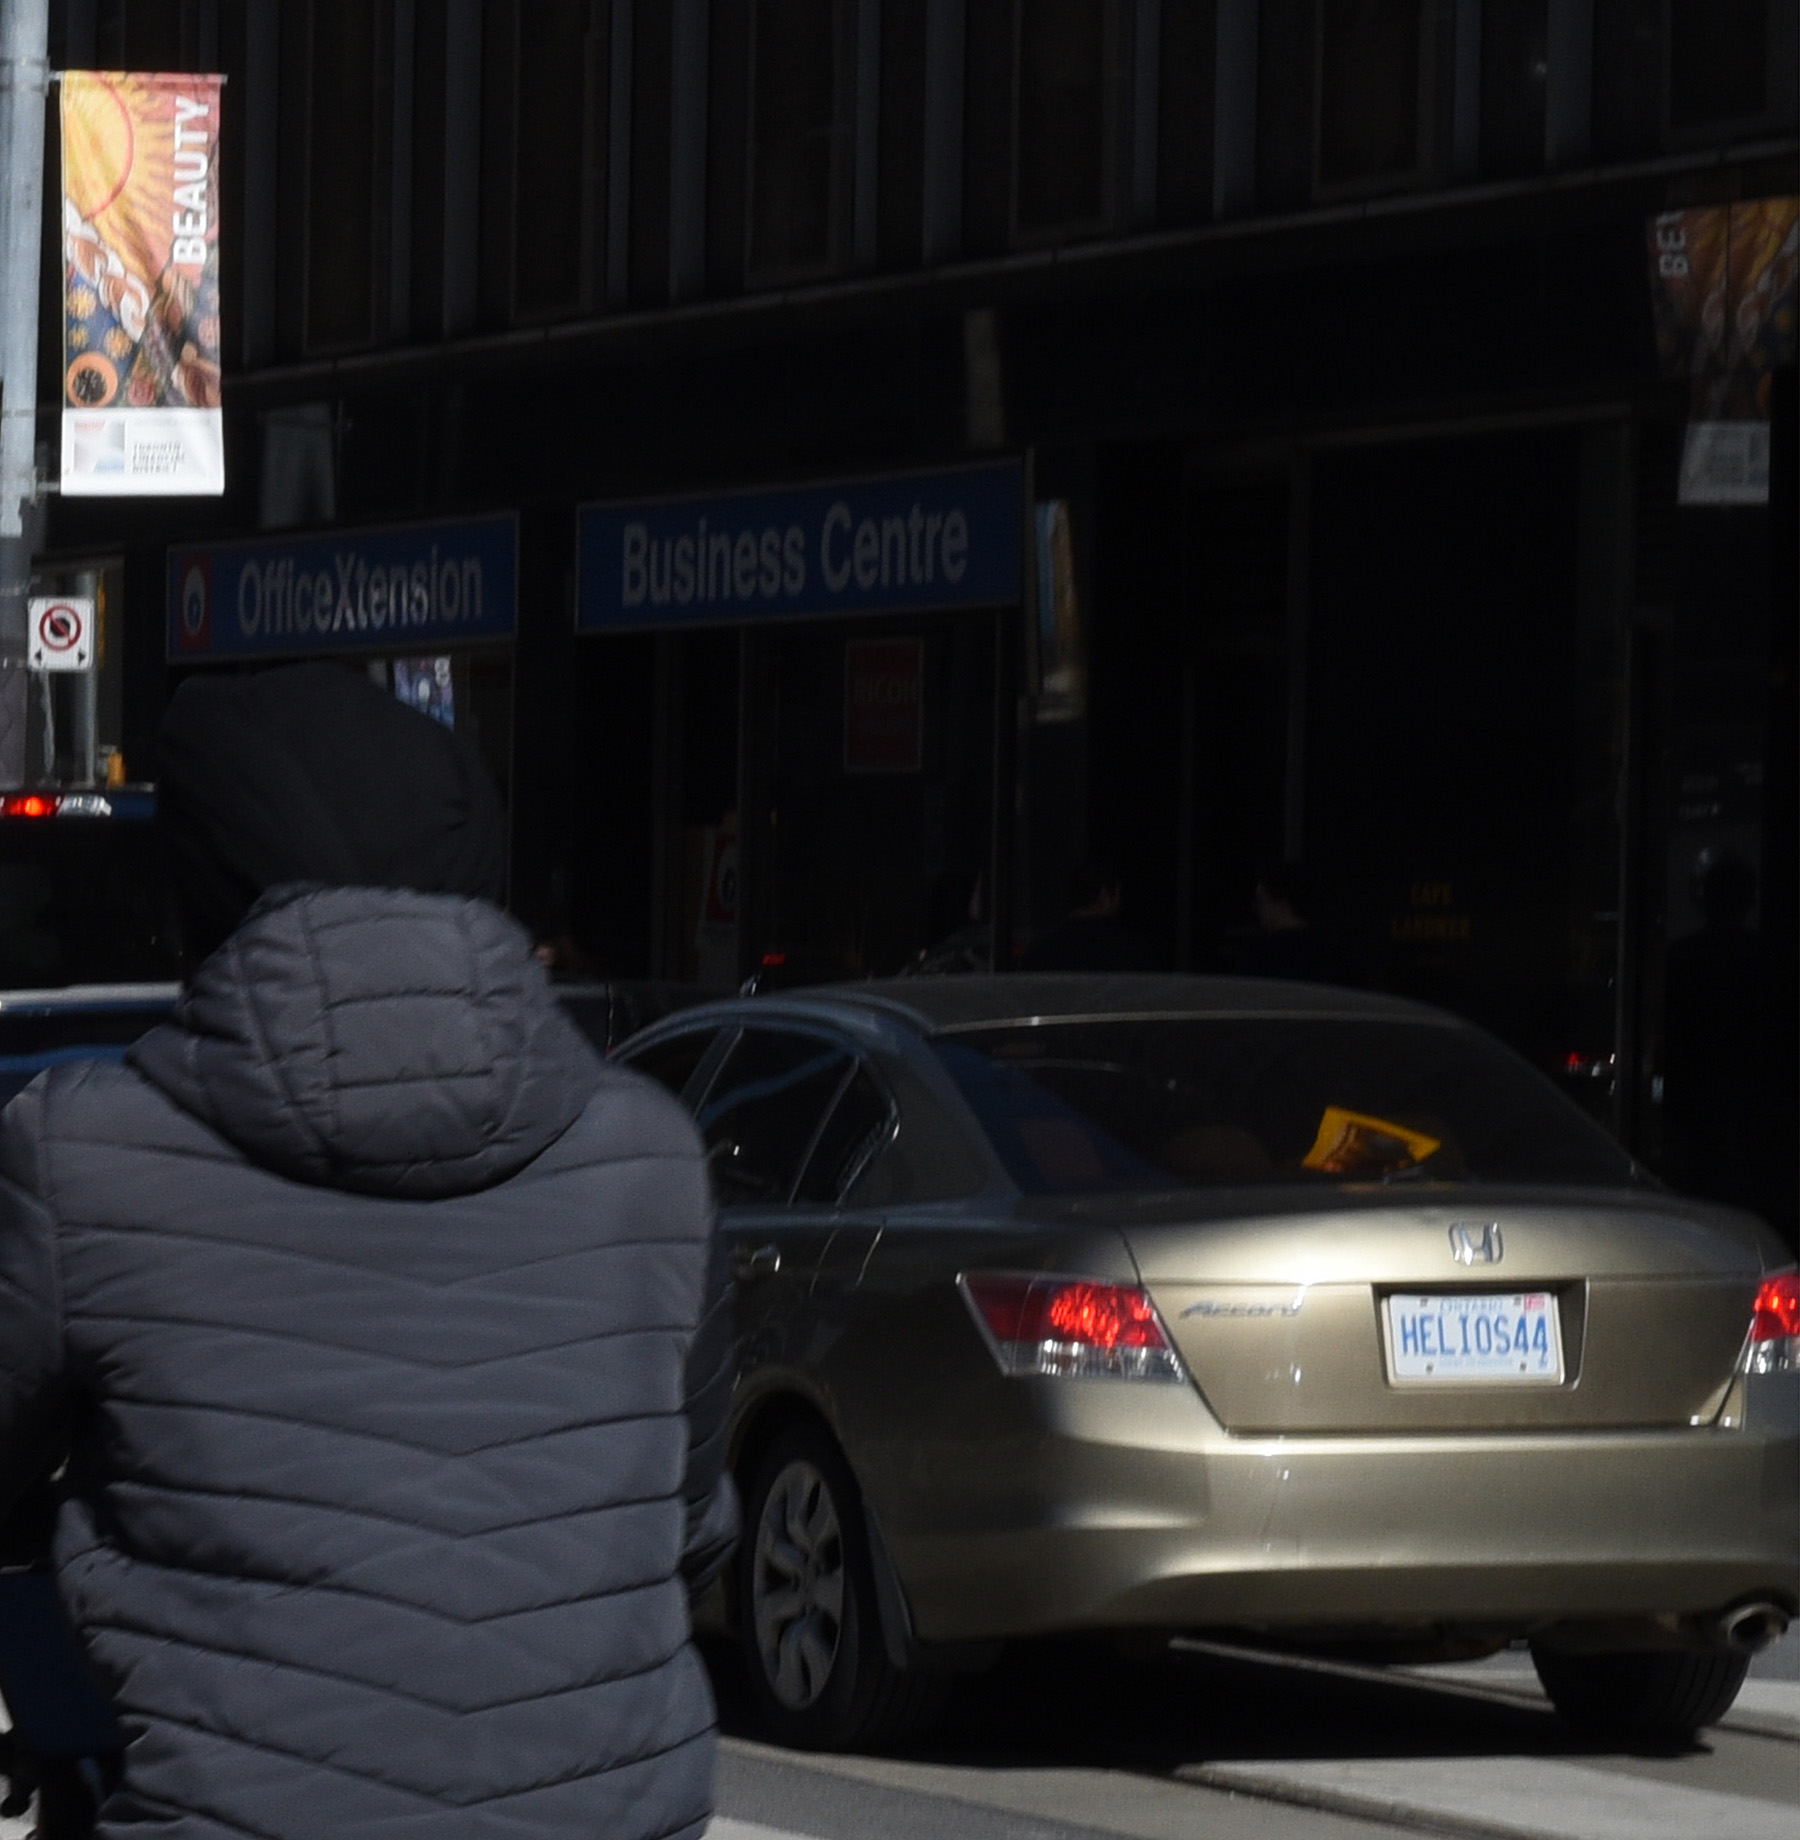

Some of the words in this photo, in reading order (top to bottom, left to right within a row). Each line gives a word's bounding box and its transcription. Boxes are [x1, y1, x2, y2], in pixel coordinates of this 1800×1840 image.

[173, 94, 209, 264] BEAUTY
[237, 541, 483, 637] OfficeXtension
[621, 516, 807, 606] Business
[821, 500, 969, 593] Centre
[1401, 1314, 1548, 1355] HELIOS44
